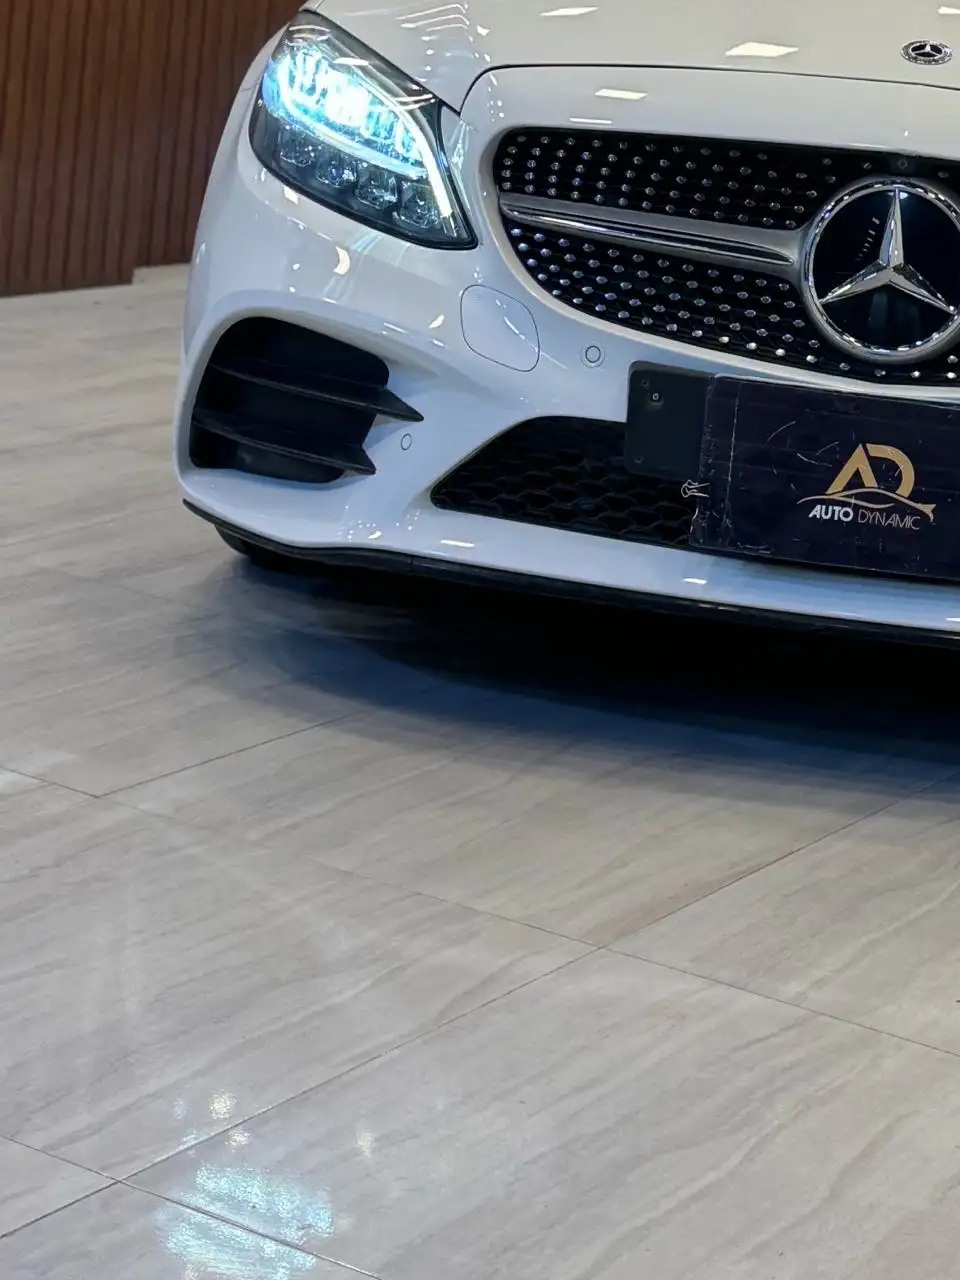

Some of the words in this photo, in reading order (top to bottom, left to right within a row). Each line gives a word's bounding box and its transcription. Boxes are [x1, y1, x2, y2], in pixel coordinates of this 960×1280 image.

[825, 443, 915, 498] AD
[808, 504, 854, 522] AUTO
[857, 509, 921, 530] DYNAMIC
